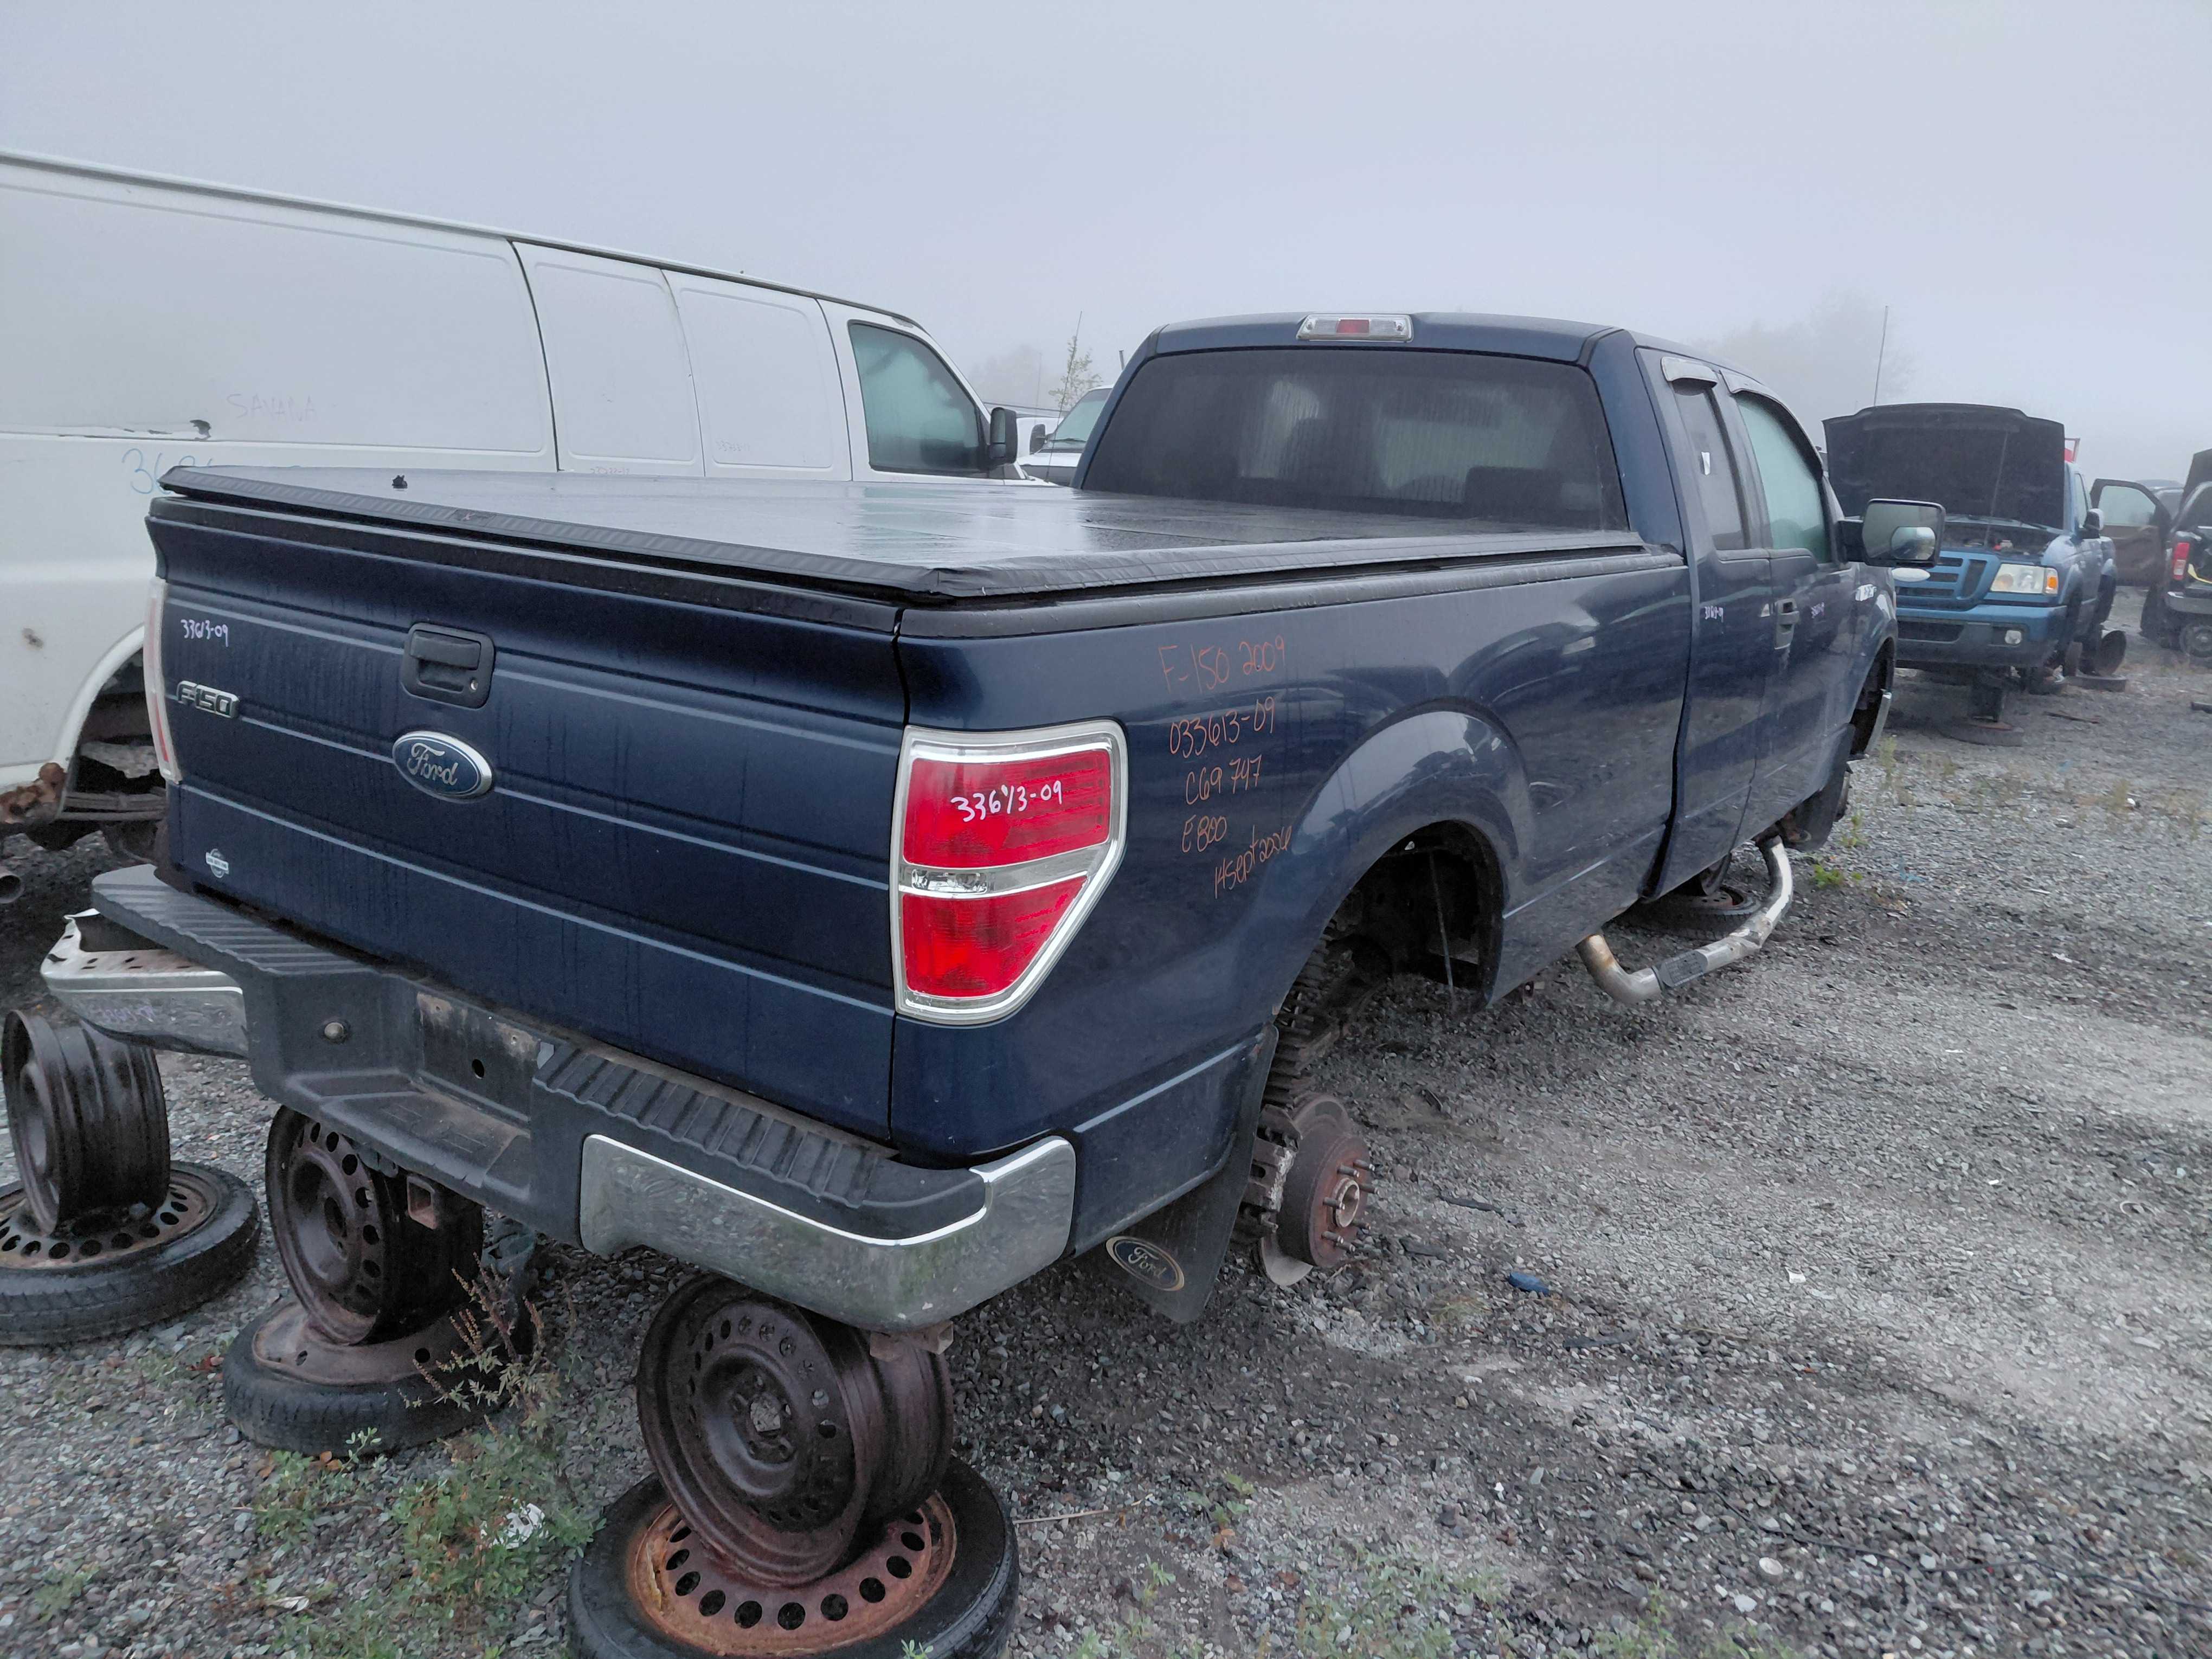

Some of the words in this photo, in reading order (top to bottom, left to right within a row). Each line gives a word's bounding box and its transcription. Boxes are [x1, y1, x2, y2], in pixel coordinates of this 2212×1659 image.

[181, 619, 228, 647] 33613-09
[1158, 644, 1230, 693] F-150
[1239, 634, 1286, 675] 2009
[1170, 697, 1275, 758] 033613-09
[407, 743, 459, 786] Ford
[1128, 1247, 1167, 1278] Ford
